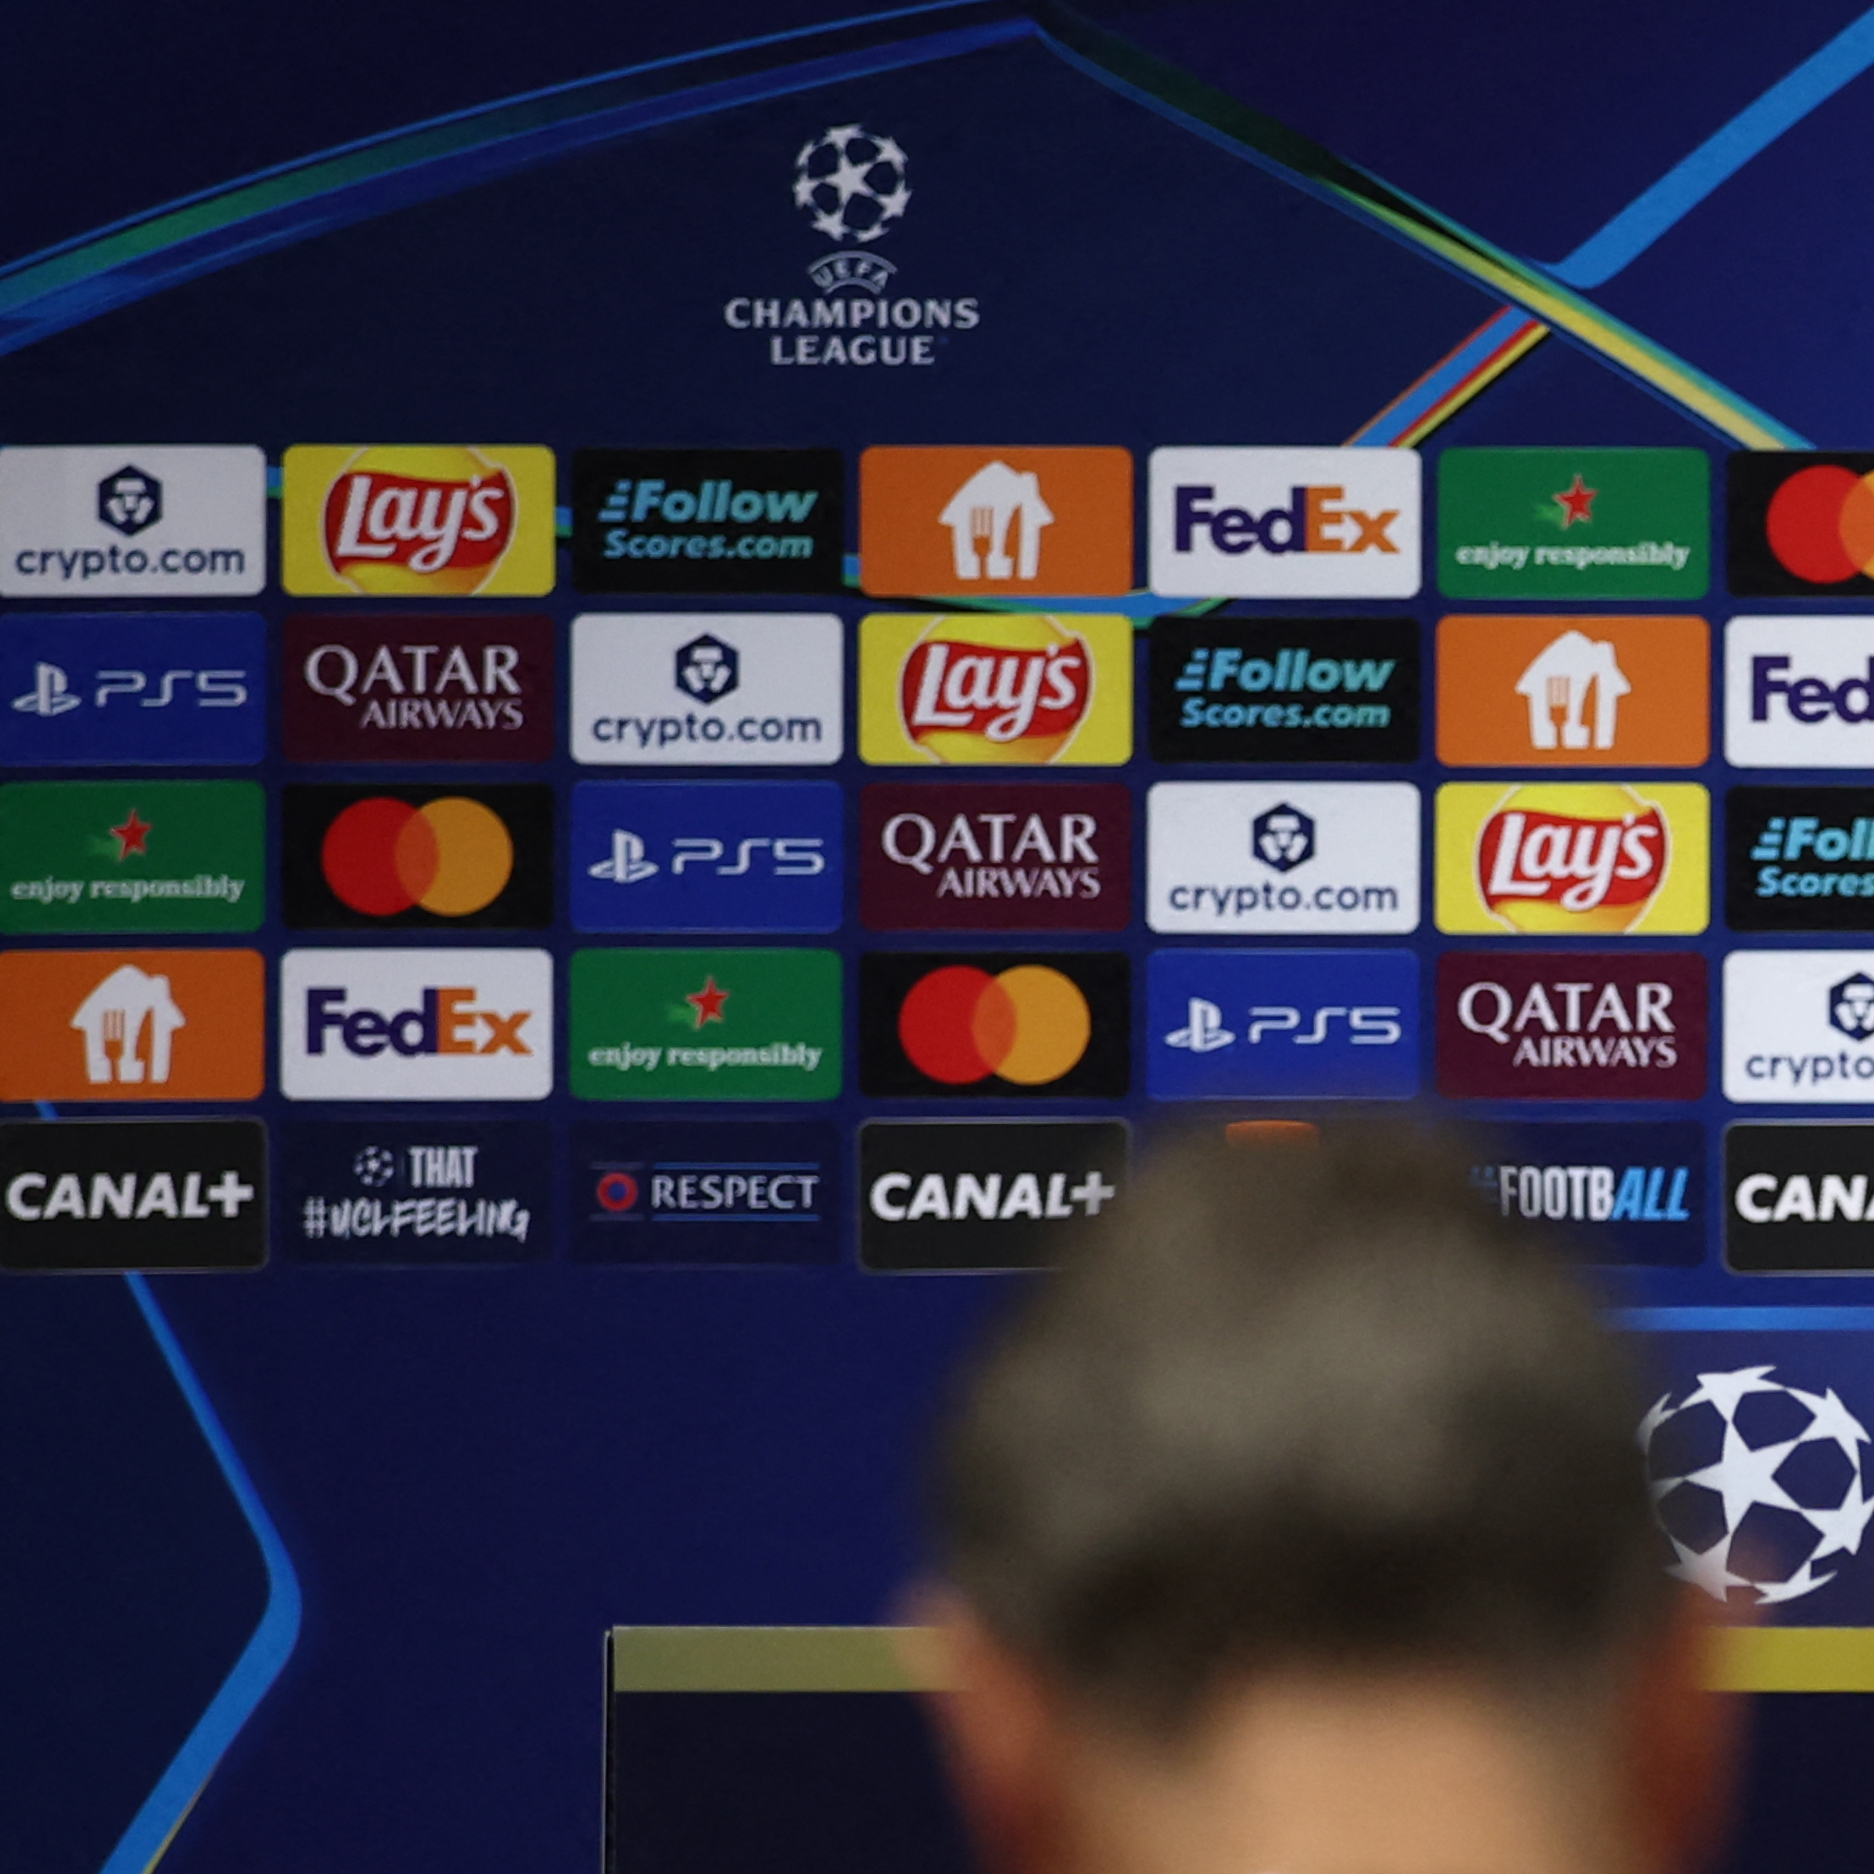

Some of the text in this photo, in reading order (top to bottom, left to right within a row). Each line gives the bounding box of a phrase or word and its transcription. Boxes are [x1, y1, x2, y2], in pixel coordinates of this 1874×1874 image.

[812, 256, 891, 289] UEFA
[724, 298, 980, 329] CHAMPIONS
[770, 336, 935, 366] LEAGUE
[631, 479, 818, 523] Follow
[336, 477, 505, 573] Lay's
[1173, 484, 1399, 556] FedEx
[603, 528, 814, 559] Scores.com
[1455, 541, 1691, 570] enjoy responsibly
[14, 544, 245, 581] crypto.com
[95, 670, 248, 707] PS5
[305, 645, 521, 705] QATAR
[1208, 648, 1394, 692] Follow
[914, 646, 1083, 742] Lay's
[1181, 697, 1391, 728] Scores.com
[362, 699, 524, 729] AIRWAYS
[591, 712, 822, 749] crypto.com
[672, 838, 825, 875] PS5
[882, 814, 1098, 881] QATAR
[1491, 816, 1660, 912] Lay's
[10, 874, 245, 904] enjoy responsibly
[939, 867, 1101, 898] AIRWAYS
[1168, 881, 1399, 917] crypto.com
[305, 986, 531, 1058] FedEx
[1248, 1007, 1401, 1044] PS5
[1458, 983, 1674, 1051] QATAR
[588, 1042, 822, 1071] enjoy responsibly
[1514, 1036, 1677, 1067] AIRWAYS
[409, 1146, 478, 1188] THAT
[6, 1171, 254, 1220] CANAL+
[652, 1176, 817, 1208] RESPECT
[870, 1172, 1116, 1223] CANAL+
[304, 1197, 530, 1241] #UCLFEELING
